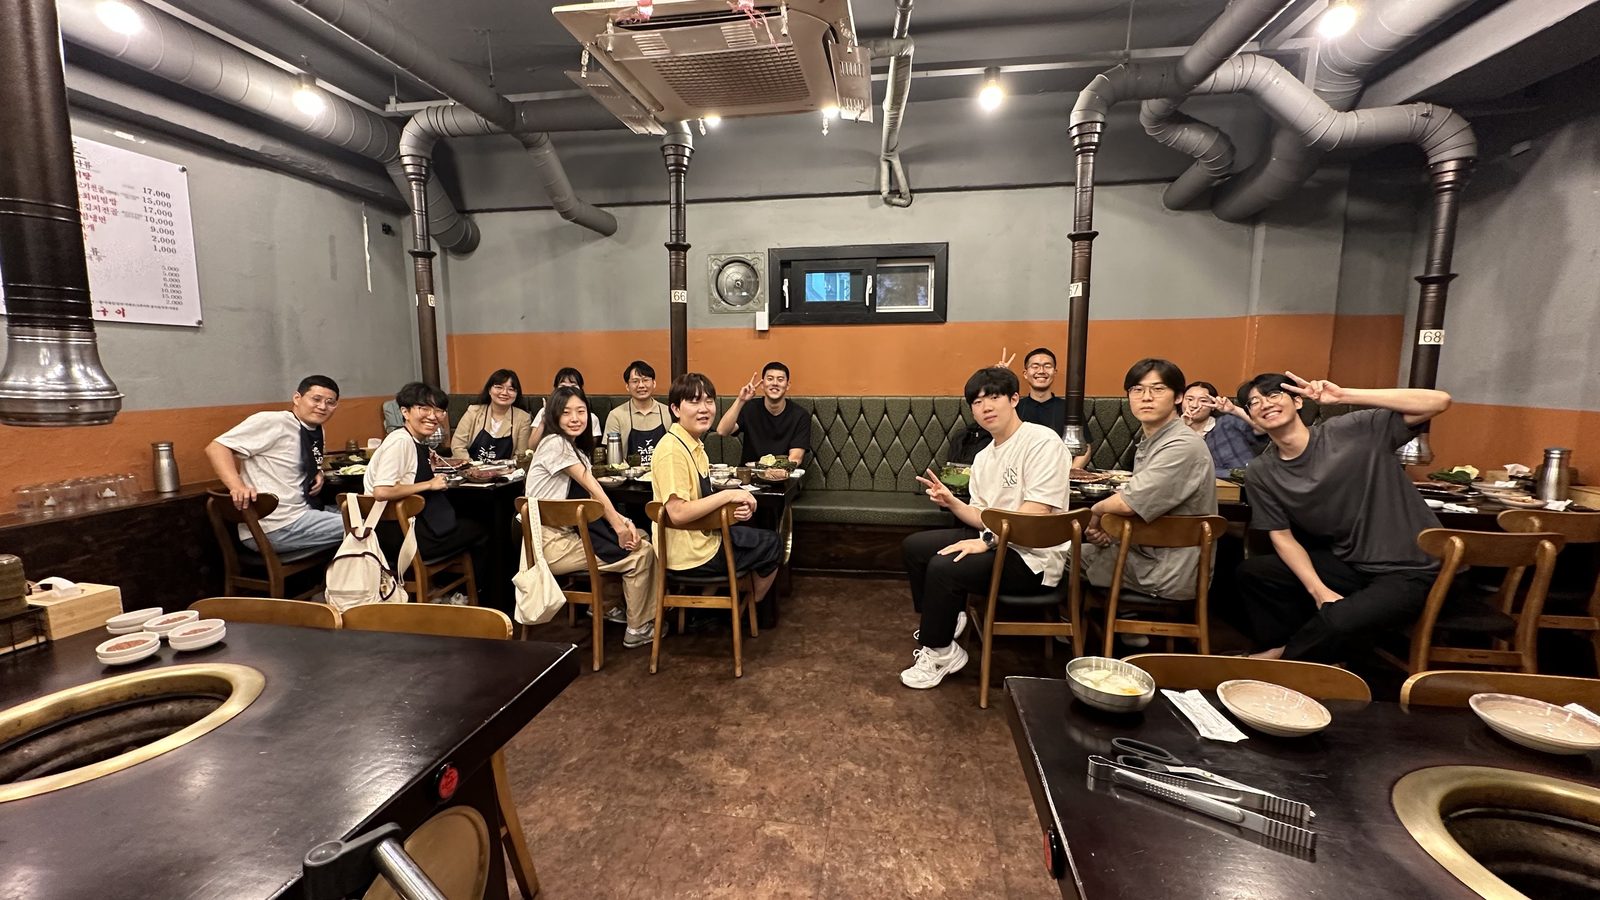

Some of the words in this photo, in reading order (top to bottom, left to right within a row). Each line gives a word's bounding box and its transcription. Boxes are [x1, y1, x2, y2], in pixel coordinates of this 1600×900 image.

[142, 187, 171, 199] 17,000
[142, 196, 172, 208] 15,000
[143, 206, 173, 218] 17,000
[144, 215, 174, 227] 10,000
[150, 226, 175, 236] 9,000
[151, 235, 176, 245] 2,000
[153, 245, 177, 254] 1,000
[673, 291, 686, 301] 66
[1423, 331, 1442, 343] 68
